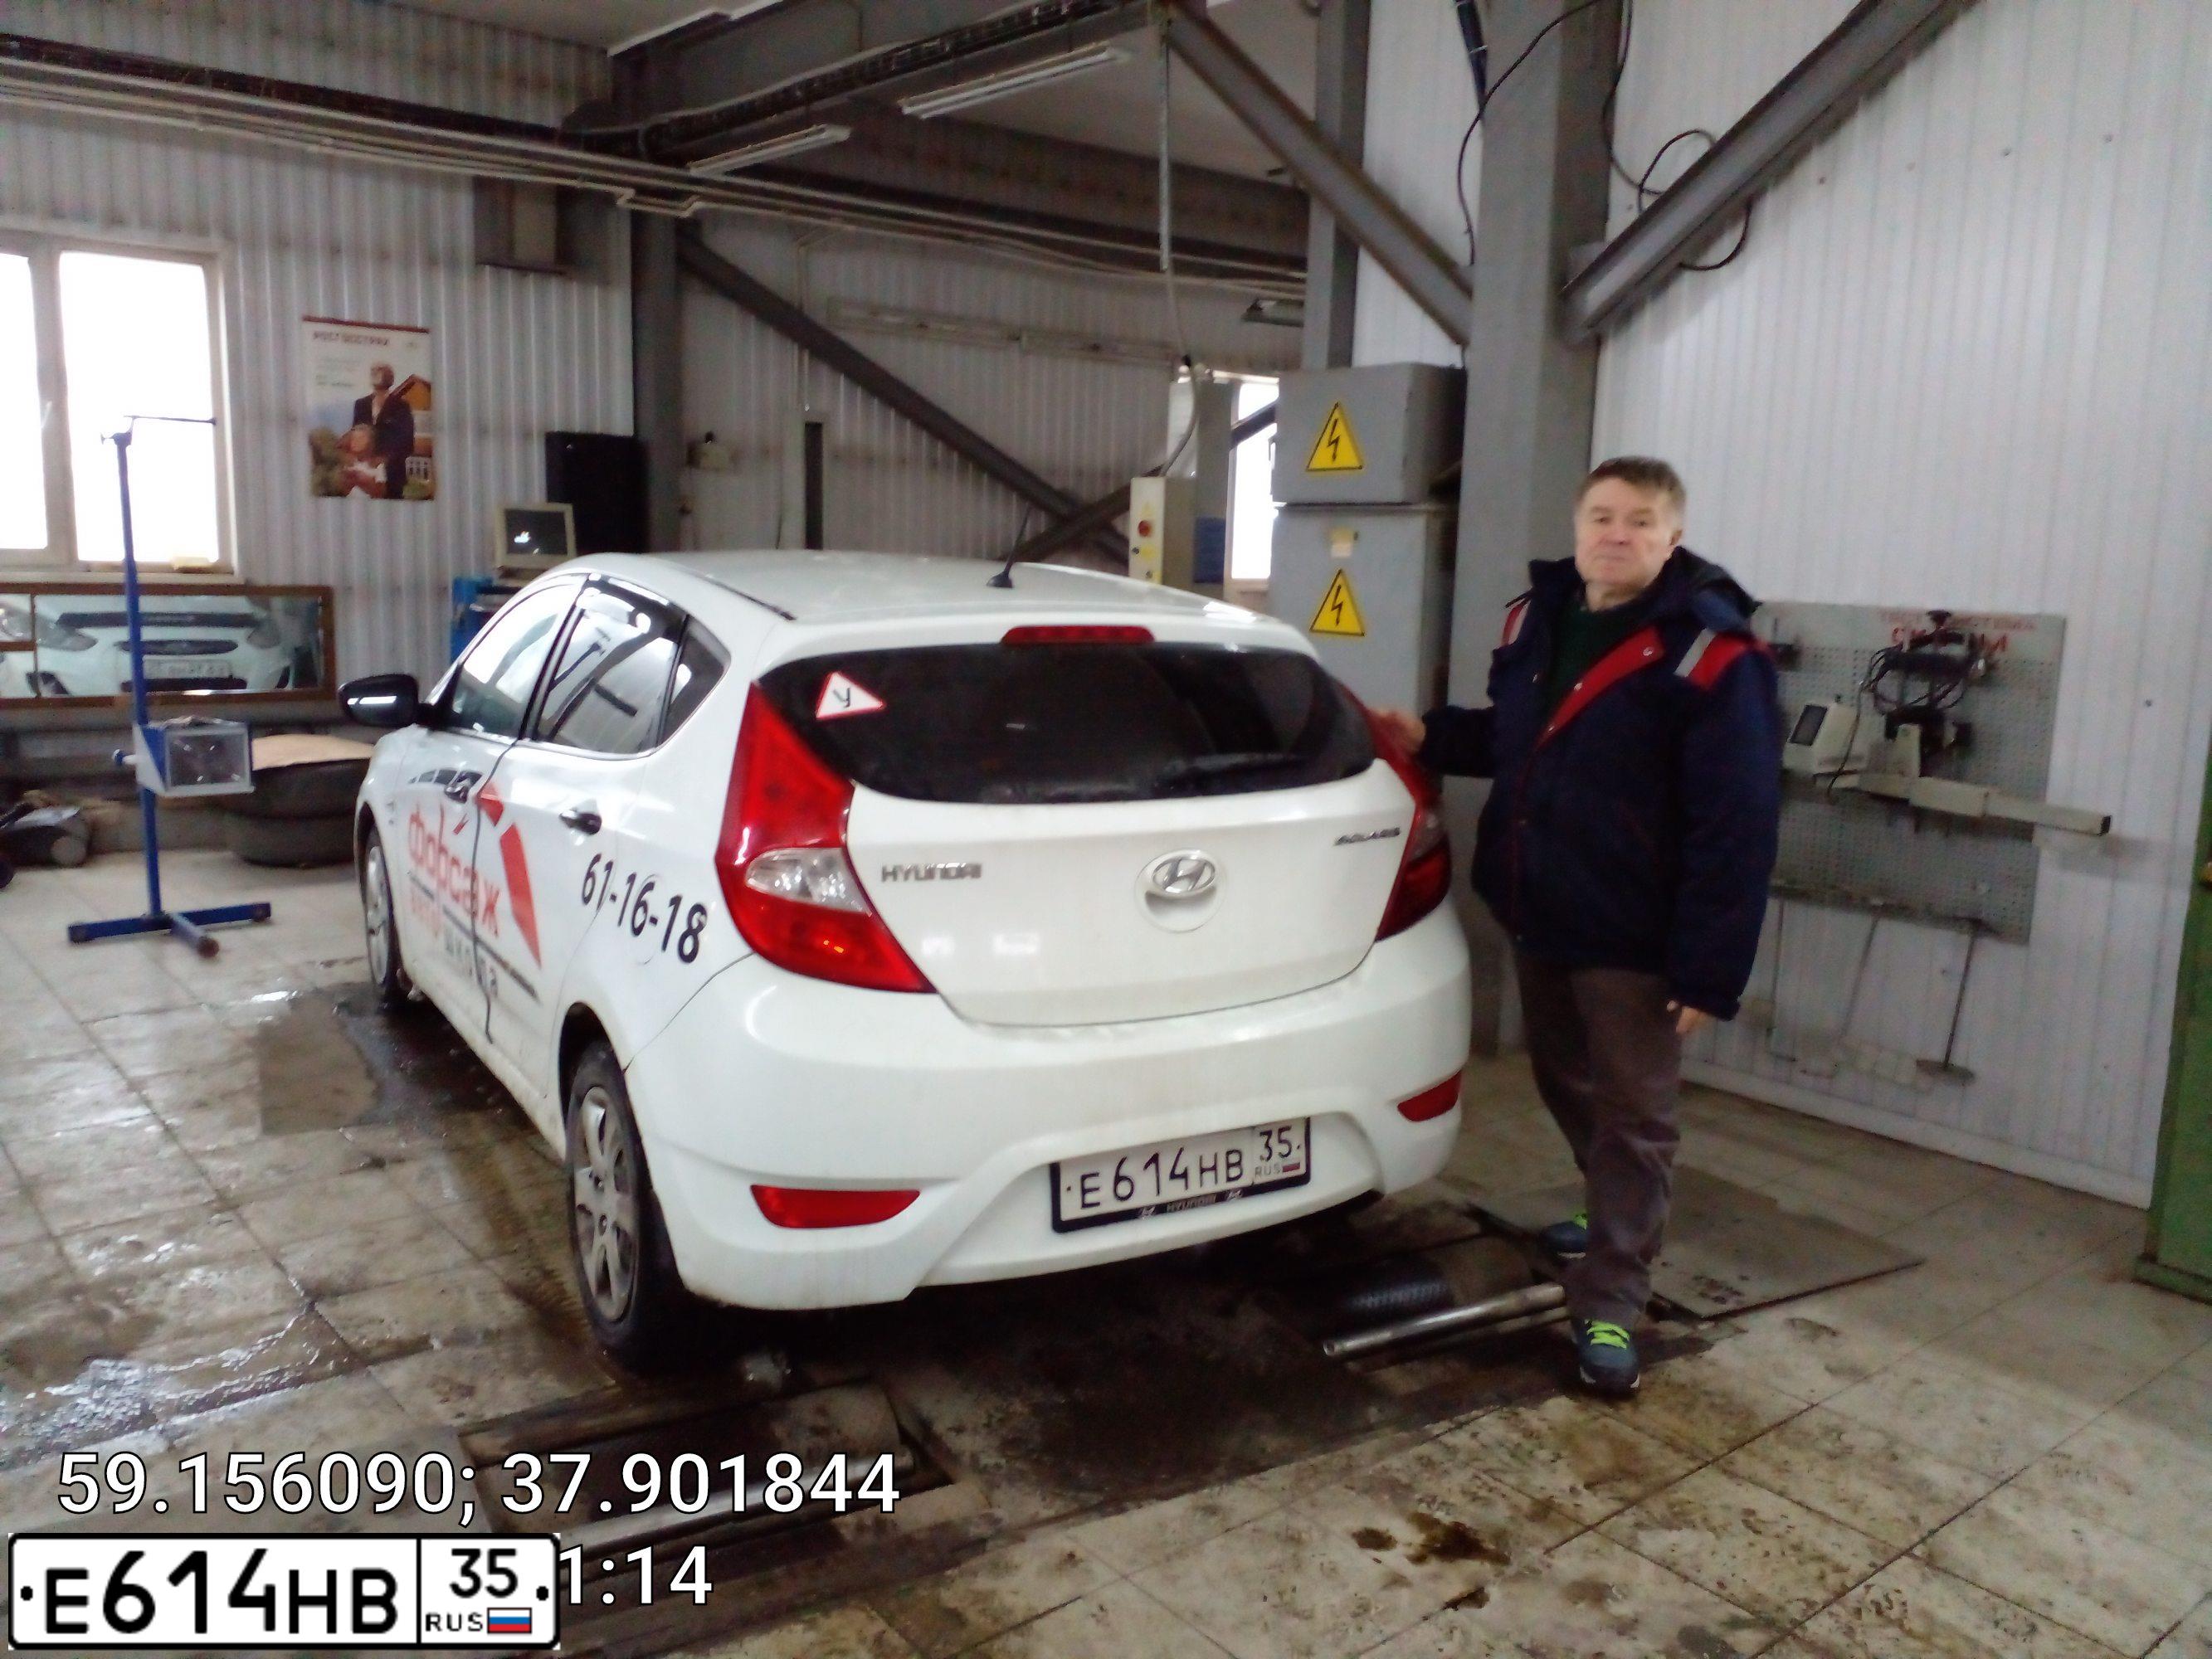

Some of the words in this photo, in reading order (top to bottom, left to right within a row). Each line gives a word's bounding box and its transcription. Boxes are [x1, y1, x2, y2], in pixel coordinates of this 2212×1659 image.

[881, 862, 982, 882] HYUNDAI
[581, 852, 708, 964] 61-16-18
[1259, 1125, 1294, 1162] 35
[1255, 1163, 1282, 1178] RUS
